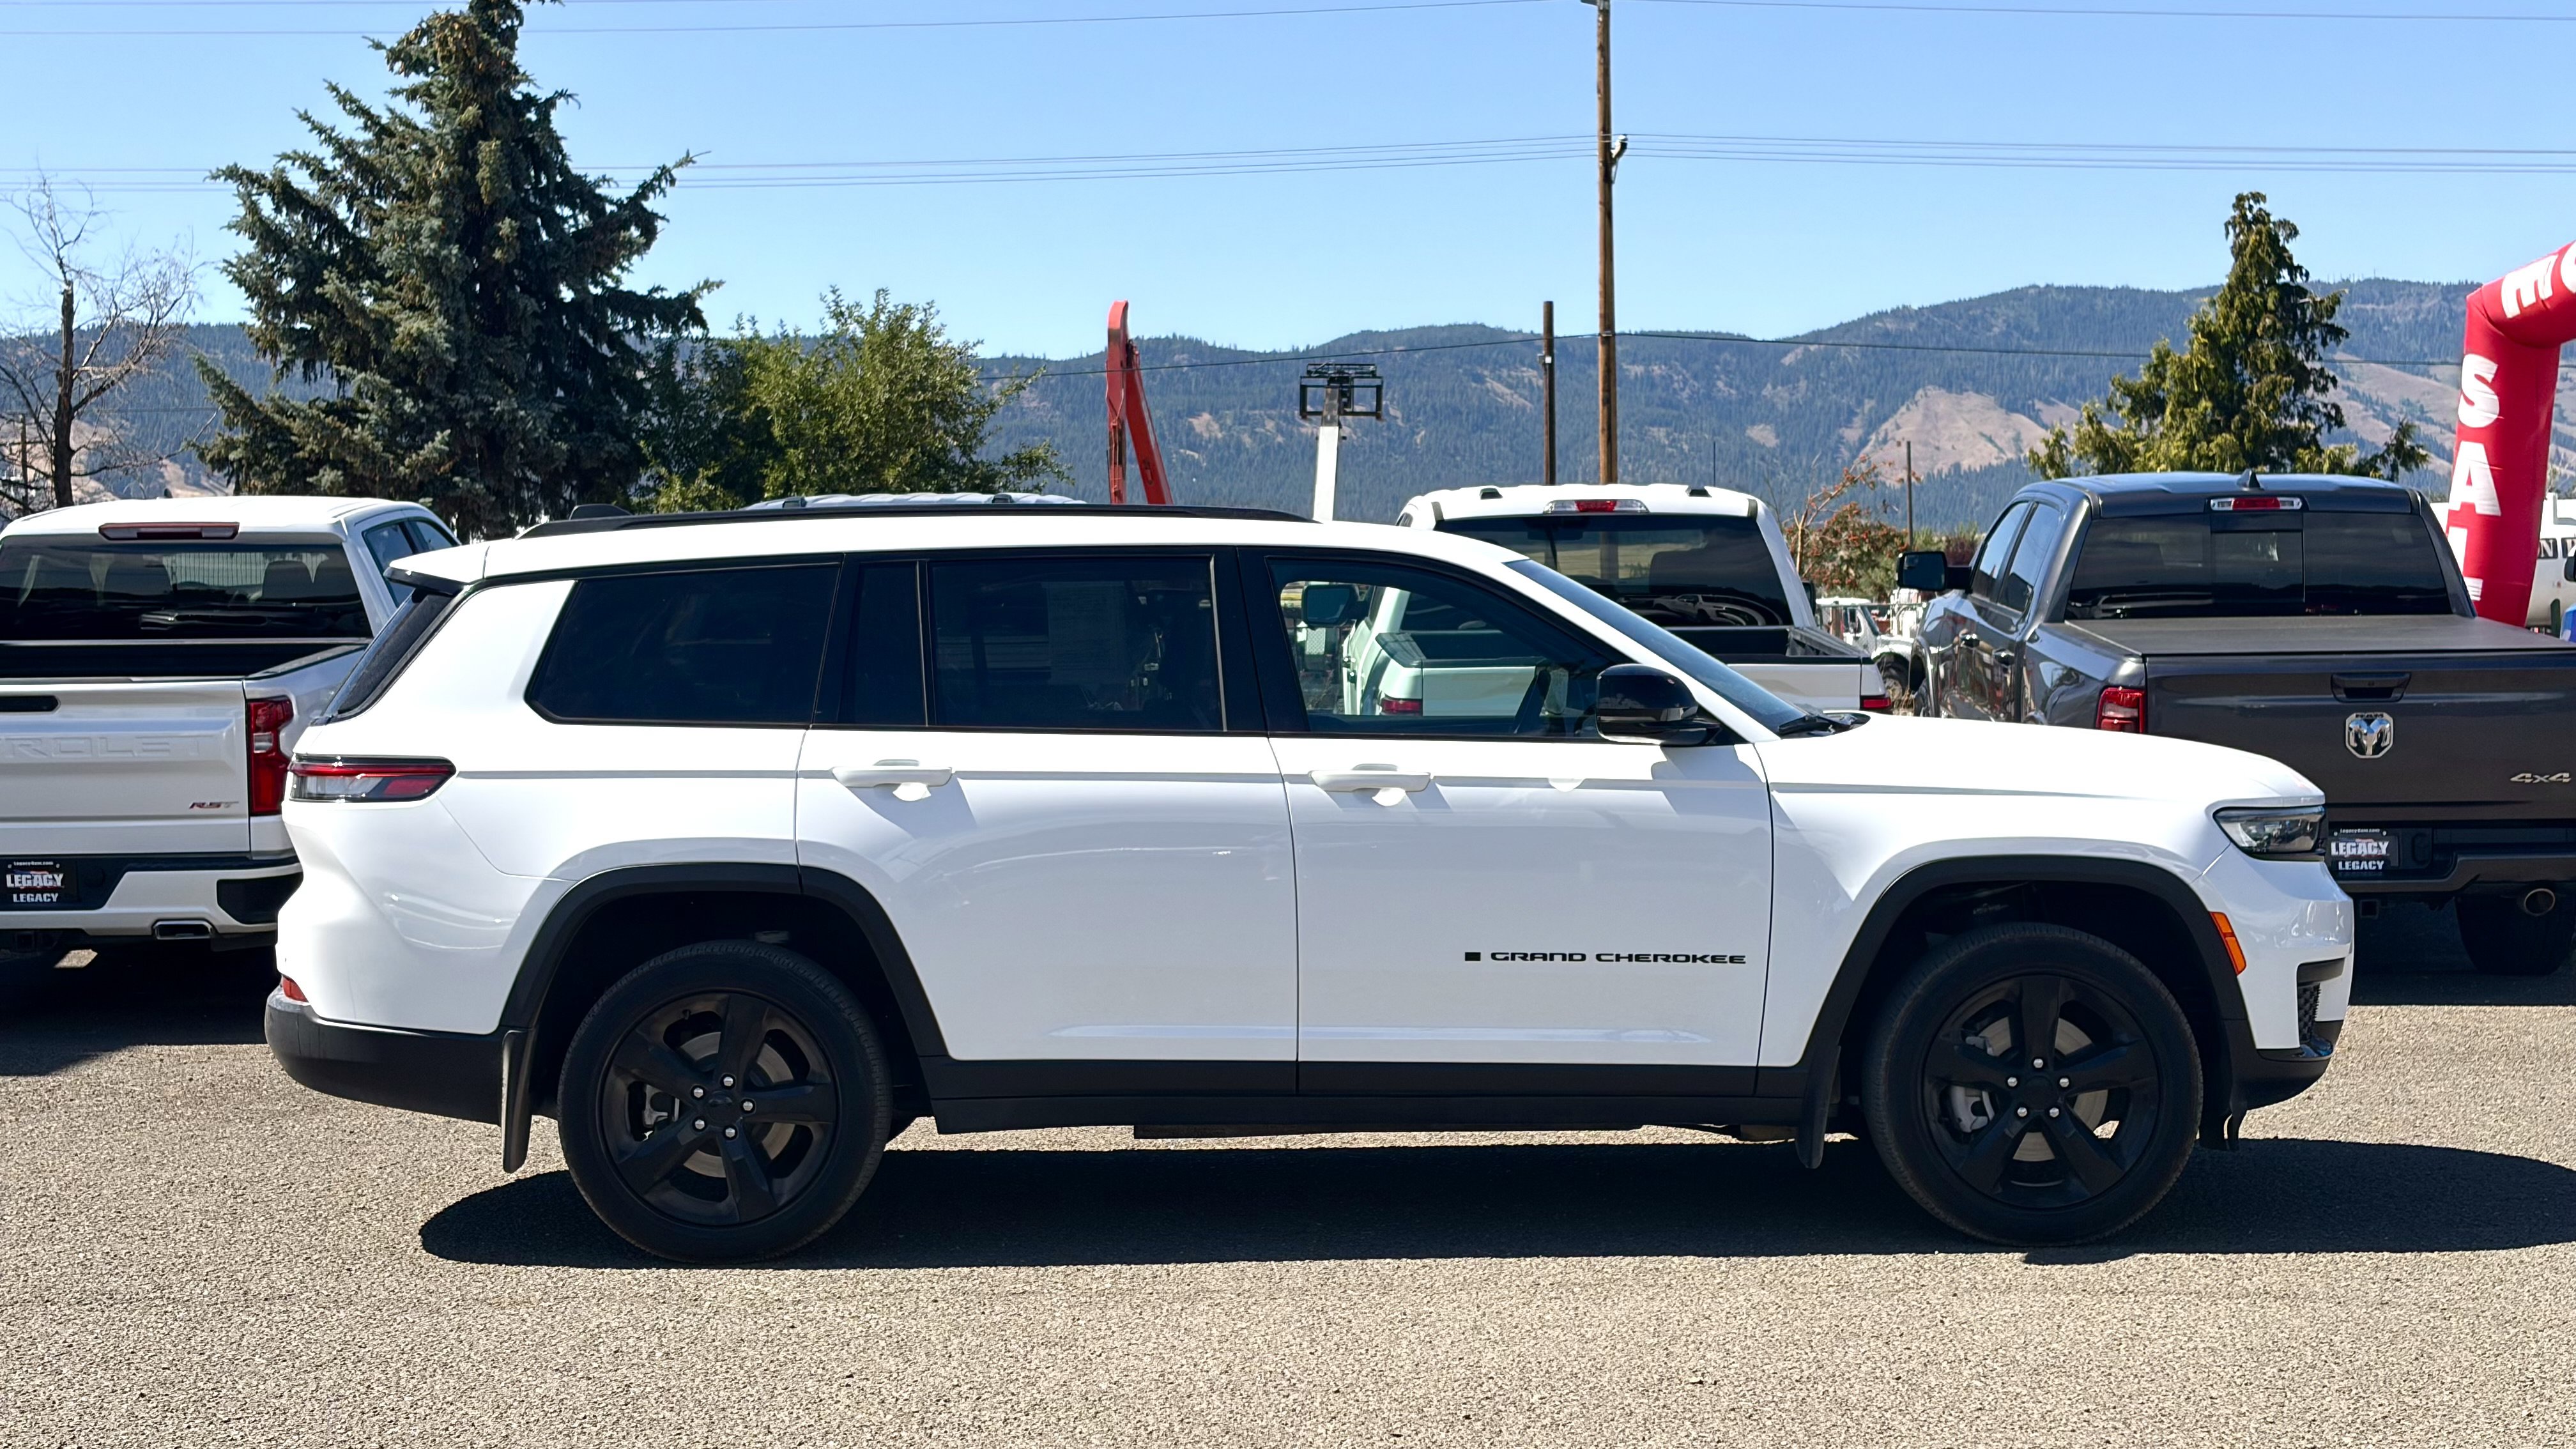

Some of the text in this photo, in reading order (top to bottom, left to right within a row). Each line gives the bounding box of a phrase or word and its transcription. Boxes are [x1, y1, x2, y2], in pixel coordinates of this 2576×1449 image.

[2510, 772, 2571, 783] 4x4
[2331, 841, 2389, 856] LEGACY
[2338, 861, 2384, 870] LEGACY
[6, 873, 63, 888] LEGACY
[13, 893, 58, 903] LEGACY
[1491, 952, 1746, 964] GRAND CHEROKEE
